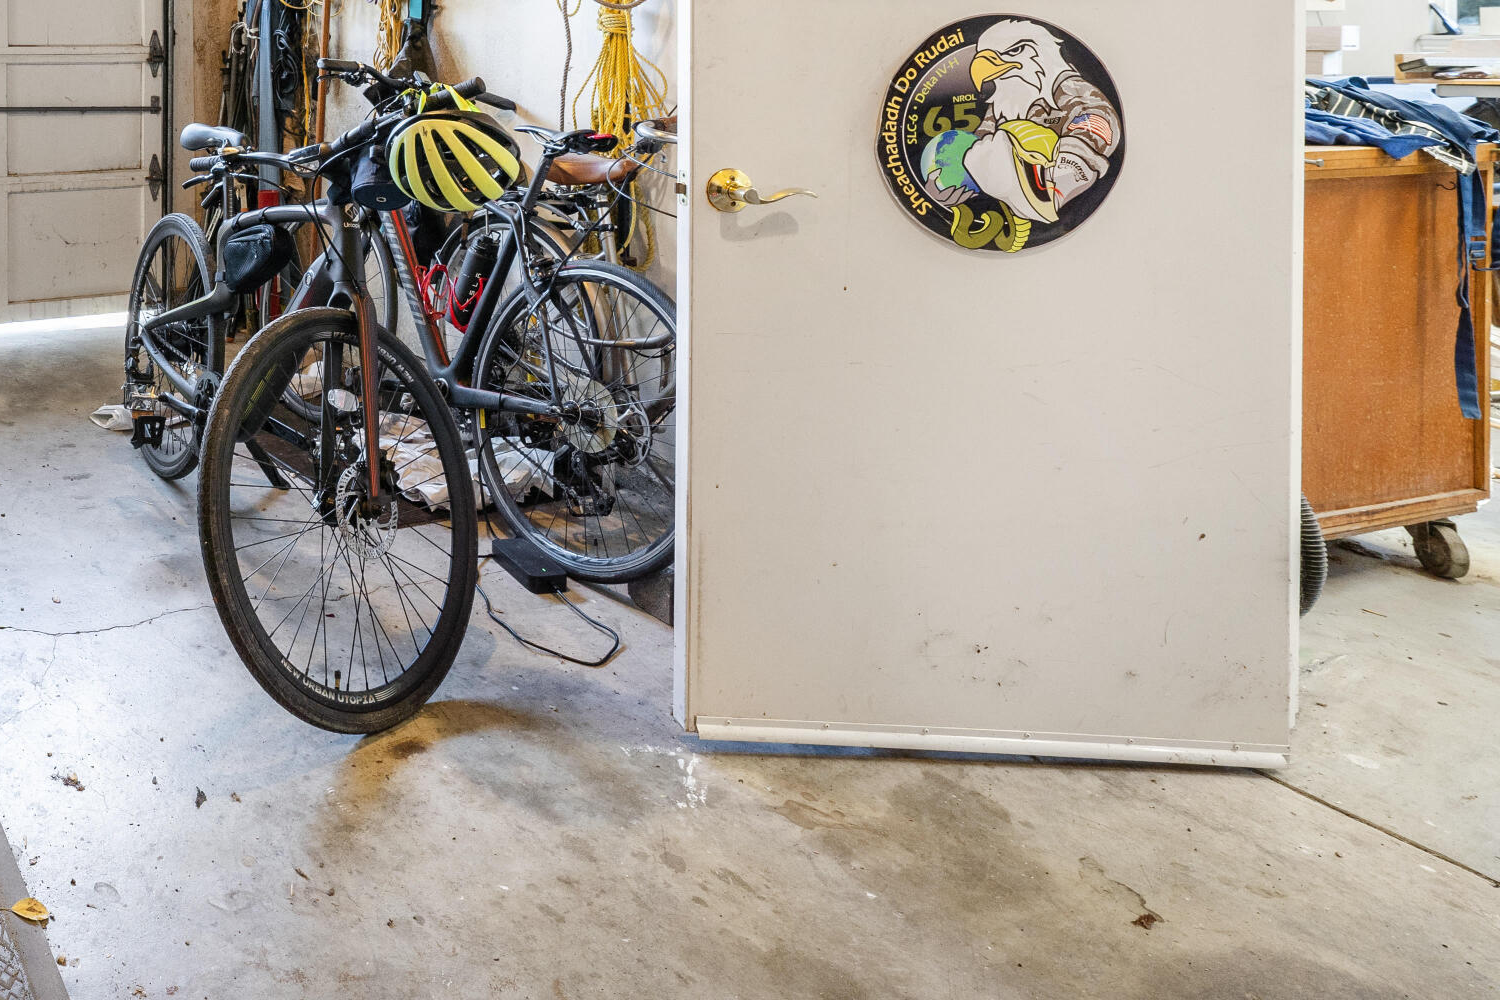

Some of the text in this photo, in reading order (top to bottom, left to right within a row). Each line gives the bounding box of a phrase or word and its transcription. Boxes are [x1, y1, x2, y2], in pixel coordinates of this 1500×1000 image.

[882, 28, 965, 216] Sheachadadh Do Rudai
[907, 57, 960, 145] SLC-6 Delta IV-H
[923, 103, 981, 138] 65
[952, 93, 978, 104] NROL
[280, 658, 376, 705] NEW URBAN UTOPIA
